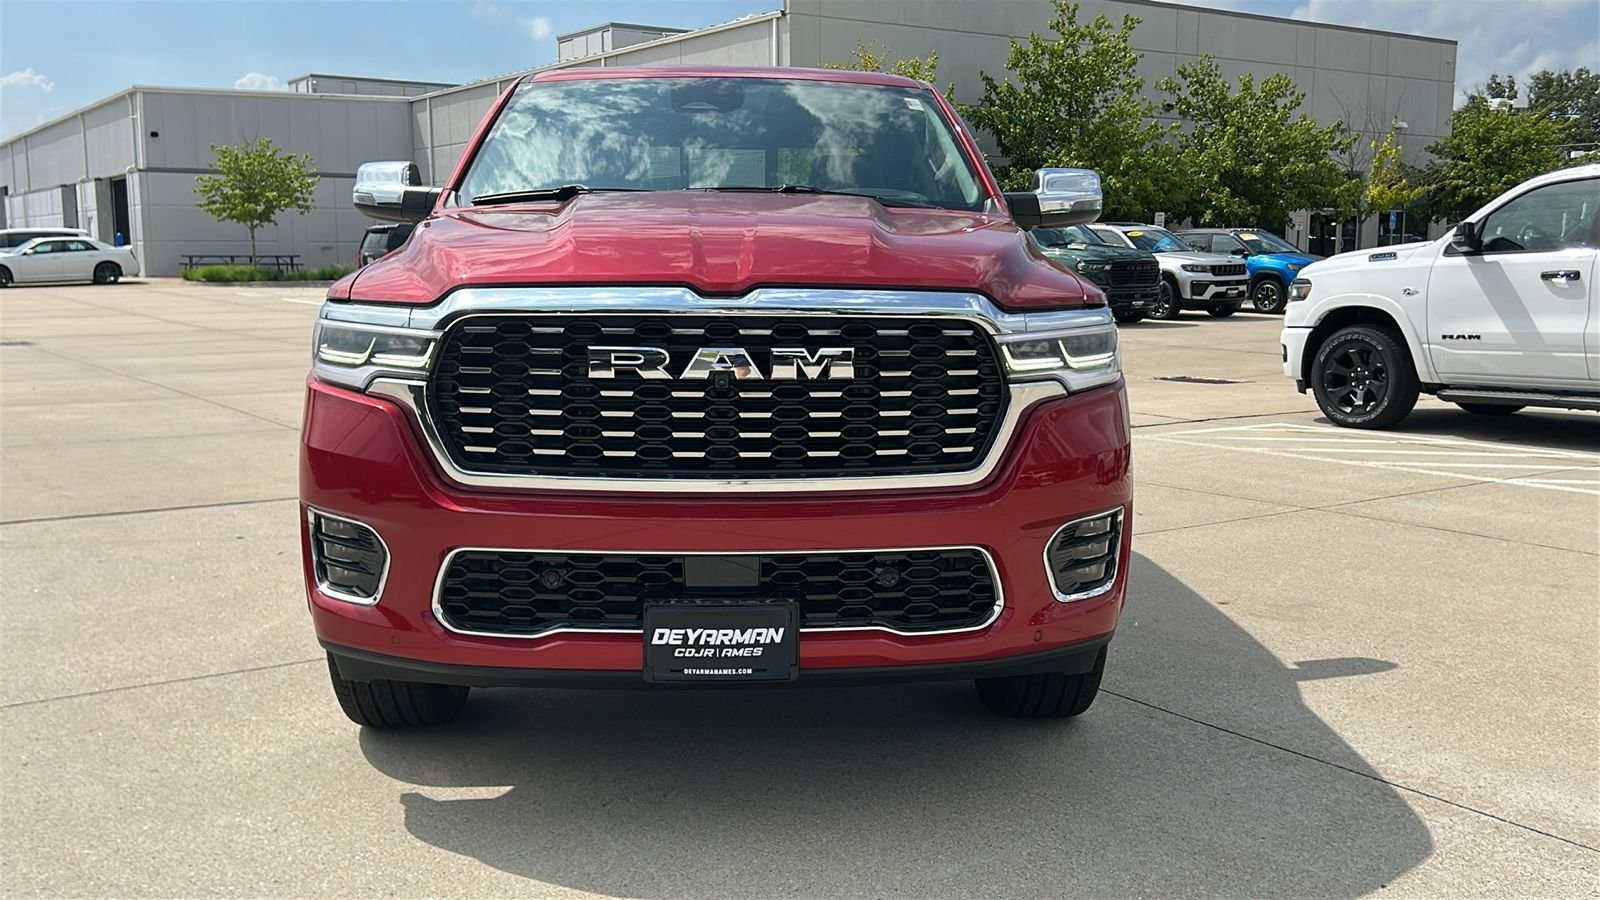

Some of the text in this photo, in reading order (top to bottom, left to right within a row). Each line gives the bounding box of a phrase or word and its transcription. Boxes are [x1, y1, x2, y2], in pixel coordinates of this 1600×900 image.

[588, 346, 855, 379] RAM
[651, 627, 785, 645] DEYARMAN
[721, 647, 764, 658] AMES
